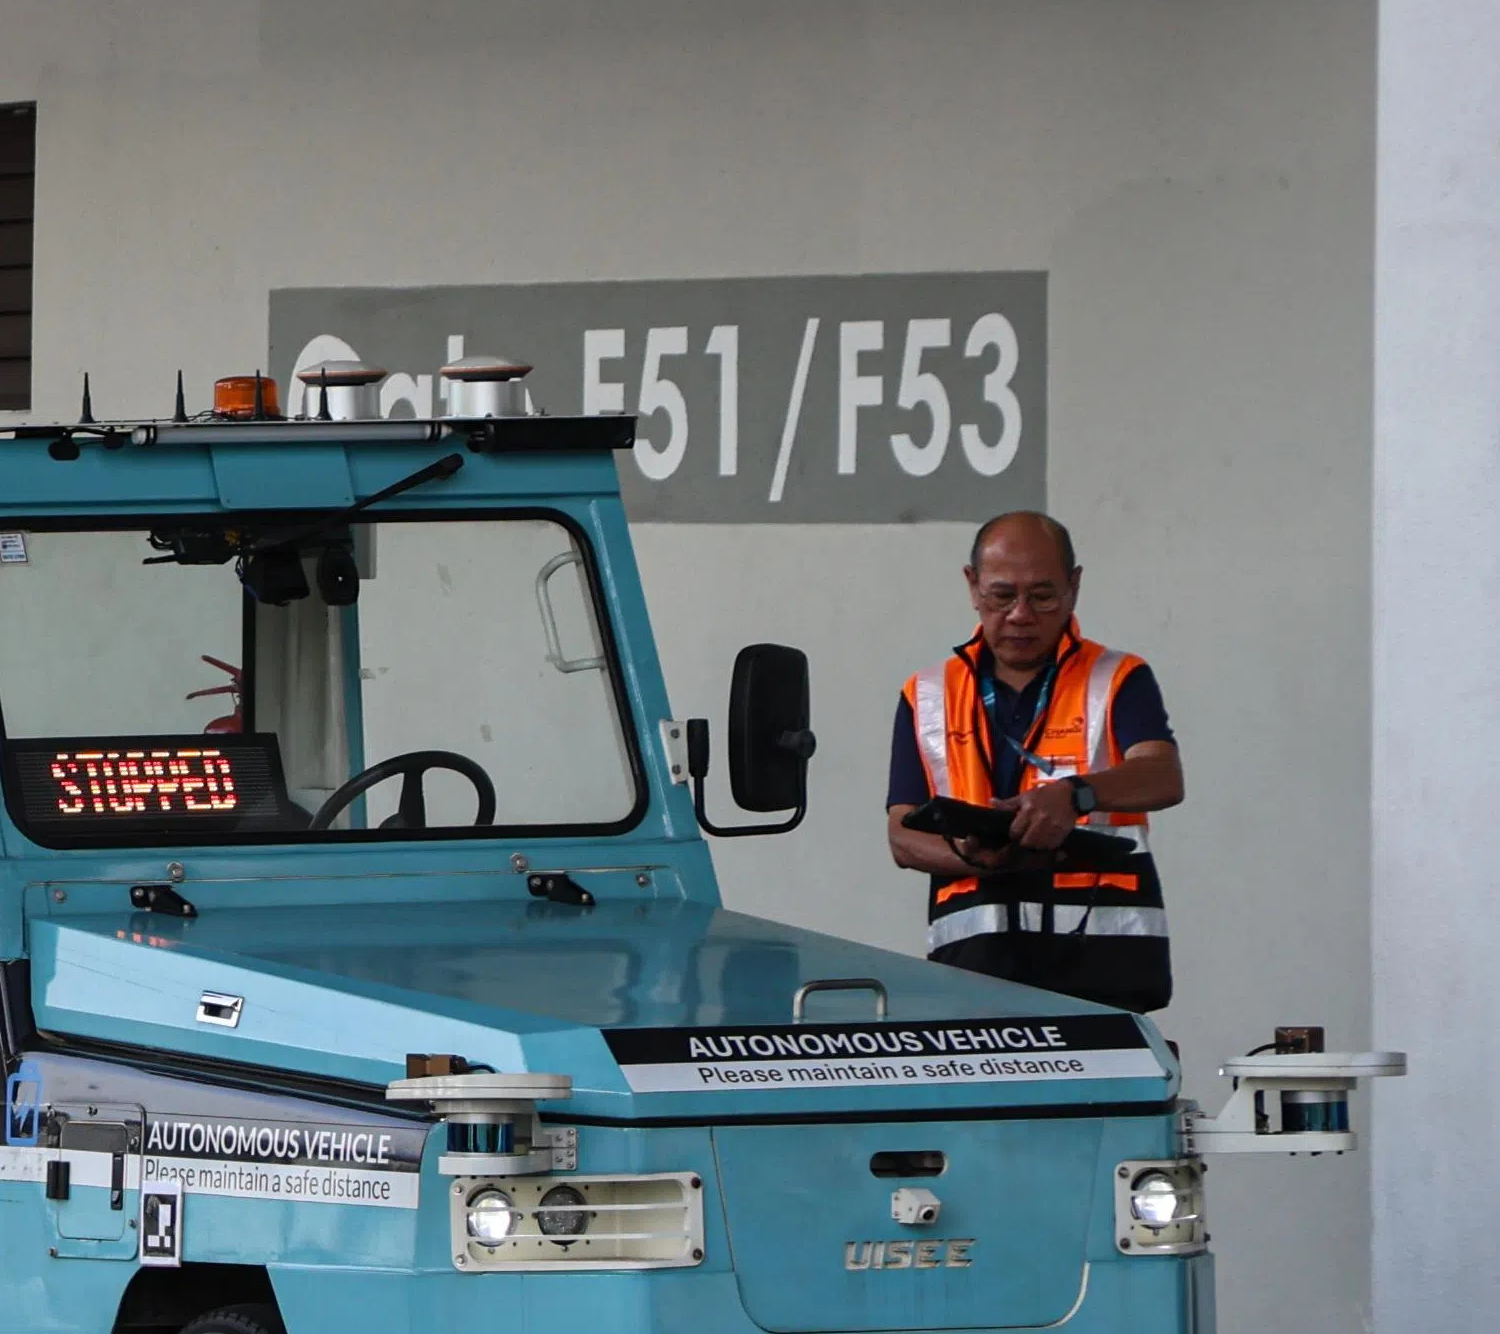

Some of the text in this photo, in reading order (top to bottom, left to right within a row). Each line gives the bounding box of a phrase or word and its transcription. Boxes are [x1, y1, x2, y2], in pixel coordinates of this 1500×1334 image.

[51, 749, 237, 813] STOPPED
[689, 1025, 1067, 1058] AUTONOMOUS VEHICLE
[698, 1055, 1085, 1084] Please maintain a safe distance
[147, 1120, 392, 1165] AUTONOMOUS VEHICLE
[145, 1158, 391, 1201] Please maintain a safe distance
